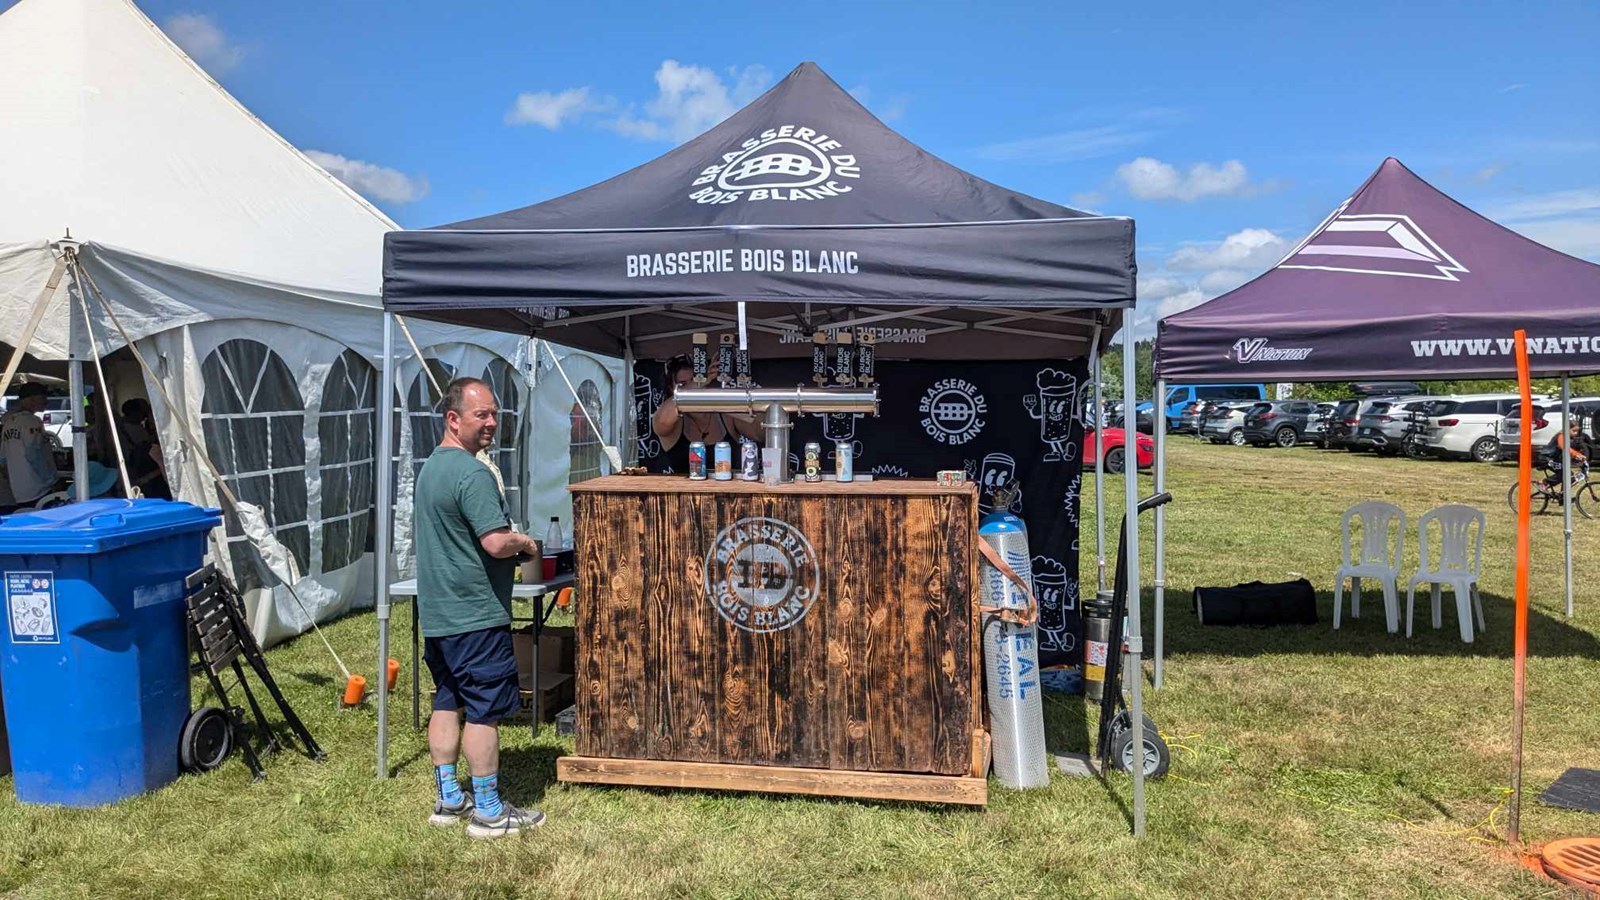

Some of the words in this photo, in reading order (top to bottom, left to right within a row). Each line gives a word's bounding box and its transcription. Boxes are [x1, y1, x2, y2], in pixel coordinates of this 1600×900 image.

[692, 125, 842, 187] BRASSERIE
[830, 154, 861, 179] DU
[688, 186, 744, 204] BOIS
[747, 180, 853, 201] BLANC
[626, 249, 734, 277] BRASSERIE
[741, 248, 785, 273] BOIS
[792, 249, 859, 274] BLANC
[1411, 336, 1600, 357] WWW.VNATI
[919, 378, 978, 413] BRASSERIE
[973, 394, 988, 414] DU
[920, 417, 946, 443] BOIS
[949, 418, 986, 445] BLANC
